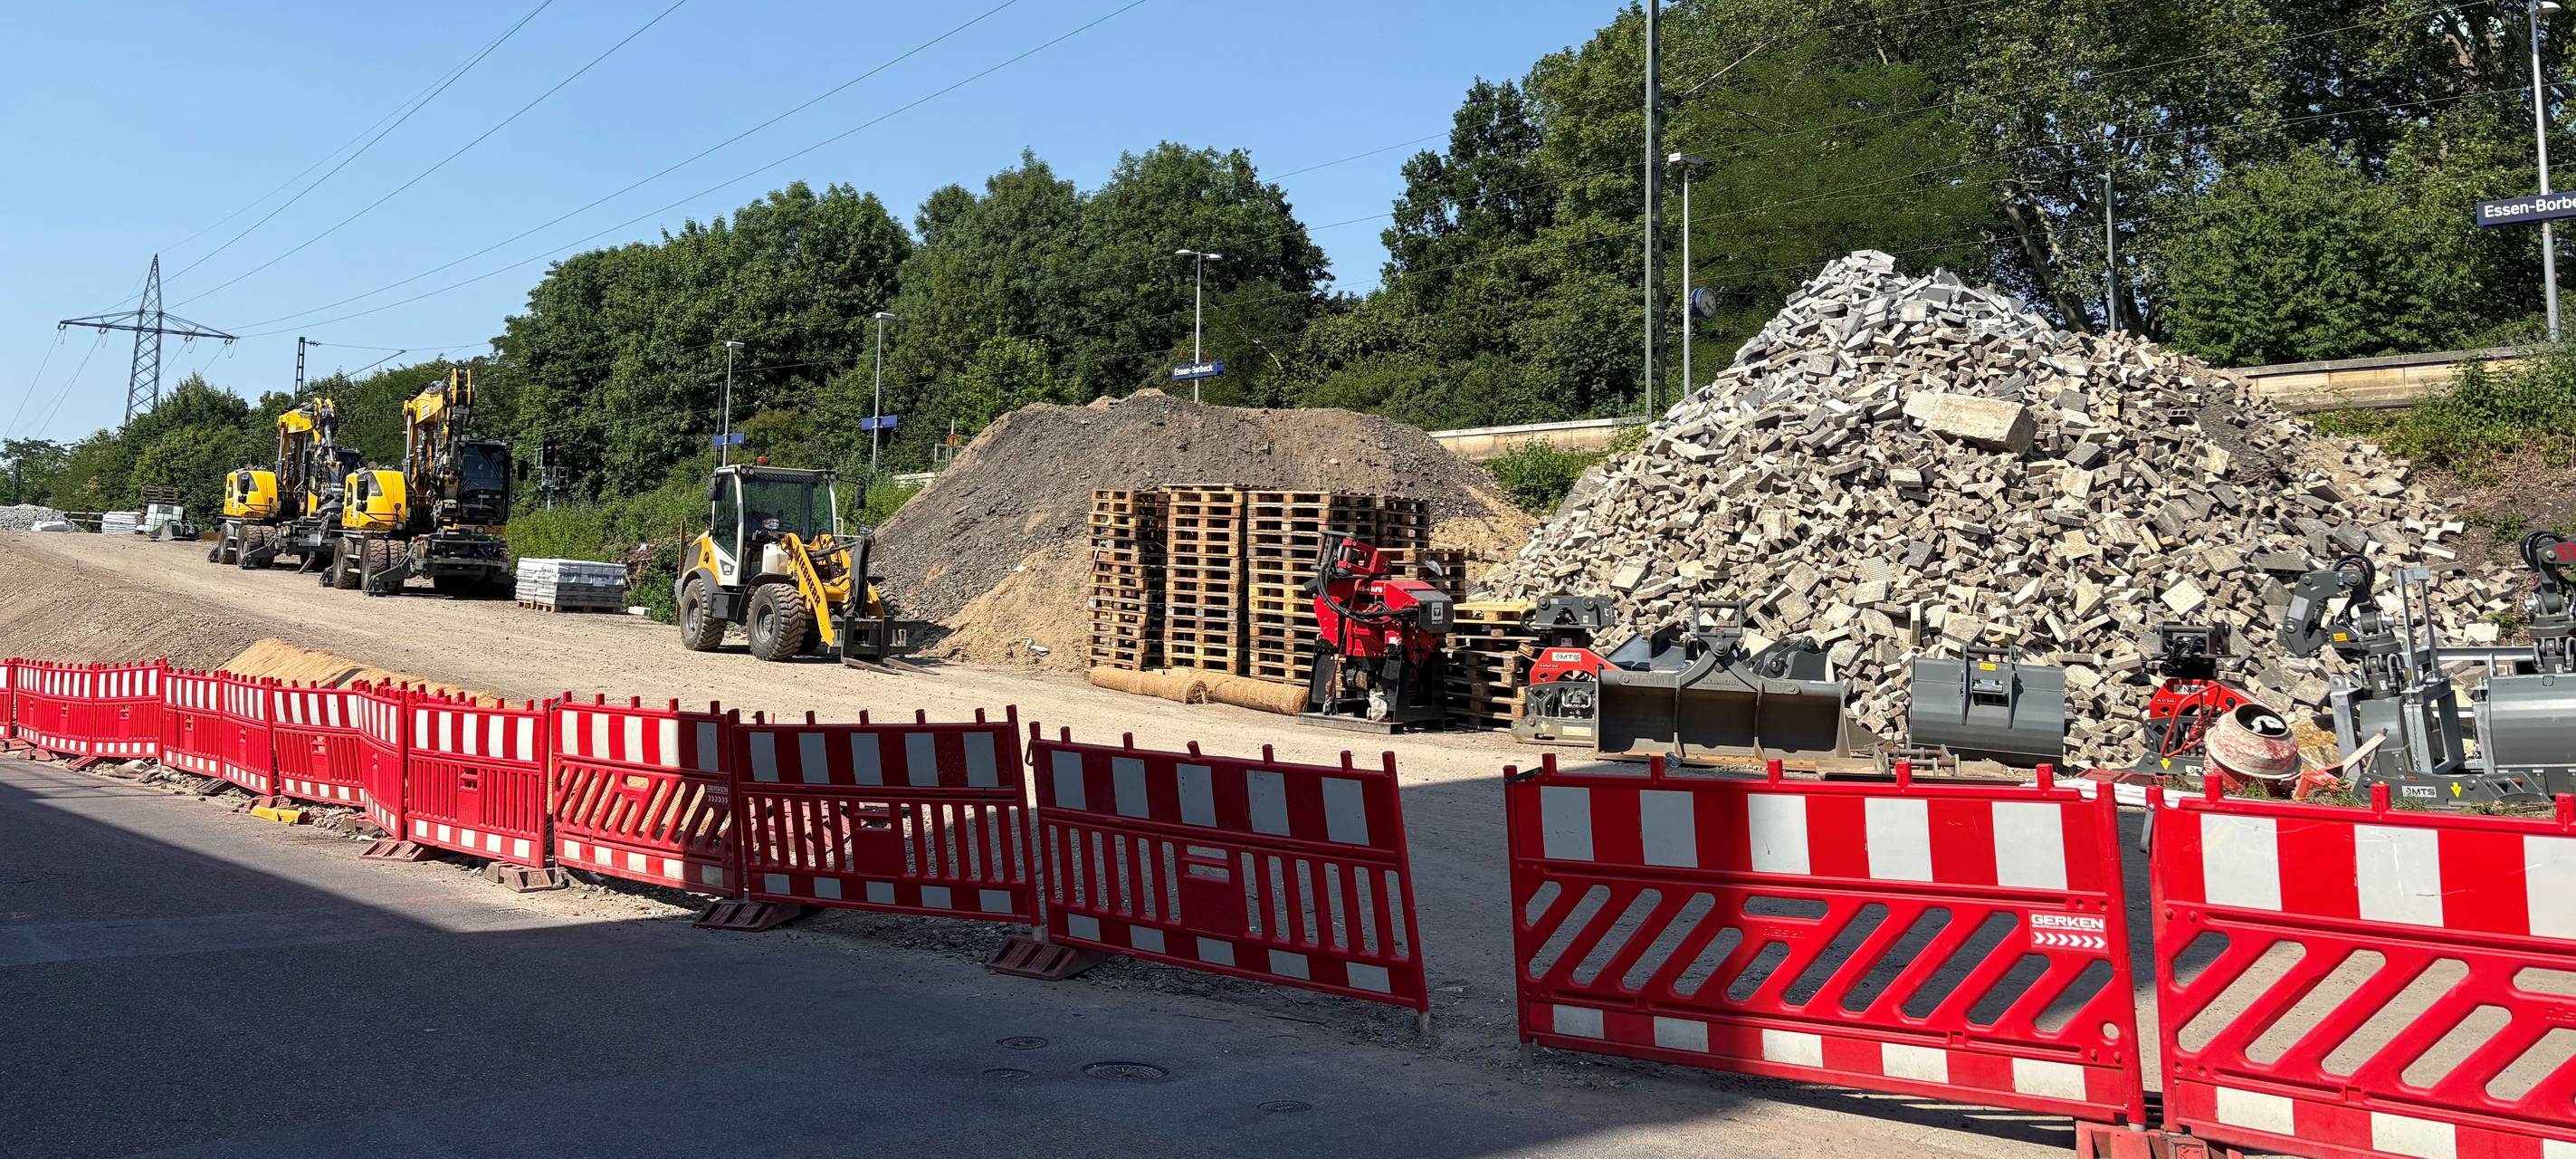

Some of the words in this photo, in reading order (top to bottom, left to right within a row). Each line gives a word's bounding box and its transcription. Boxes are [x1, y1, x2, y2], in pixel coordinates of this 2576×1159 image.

[1174, 364, 1214, 376] Essen-Borbeck
[2412, 788, 2436, 796] MTS
[2031, 914, 2104, 929] GERKEN
